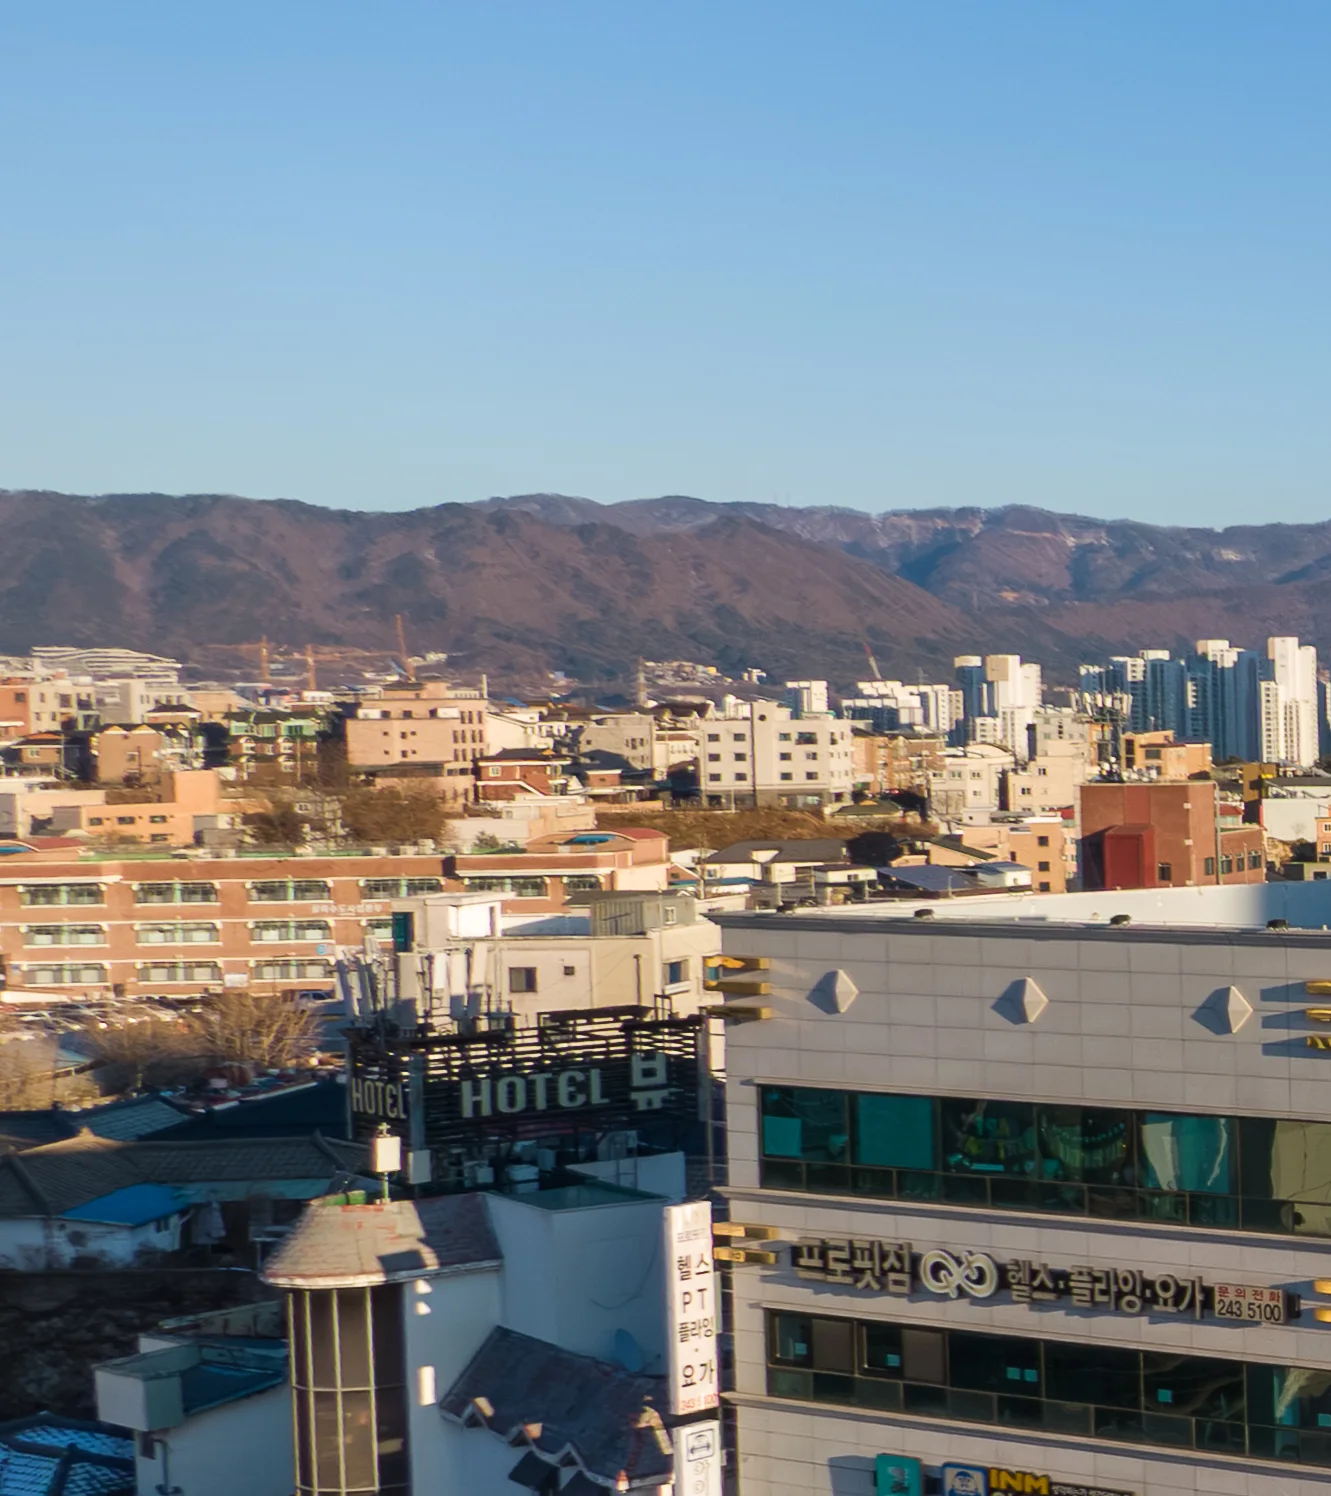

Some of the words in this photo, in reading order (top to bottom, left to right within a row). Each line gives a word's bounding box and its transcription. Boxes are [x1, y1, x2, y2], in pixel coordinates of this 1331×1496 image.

[351, 1077, 407, 1119] HOTEL
[460, 1066, 610, 1118] HOTEL
[797, 1236, 912, 1295] 프로핏짐
[681, 1359, 715, 1389] 요가
[989, 1468, 1049, 1495] INM
